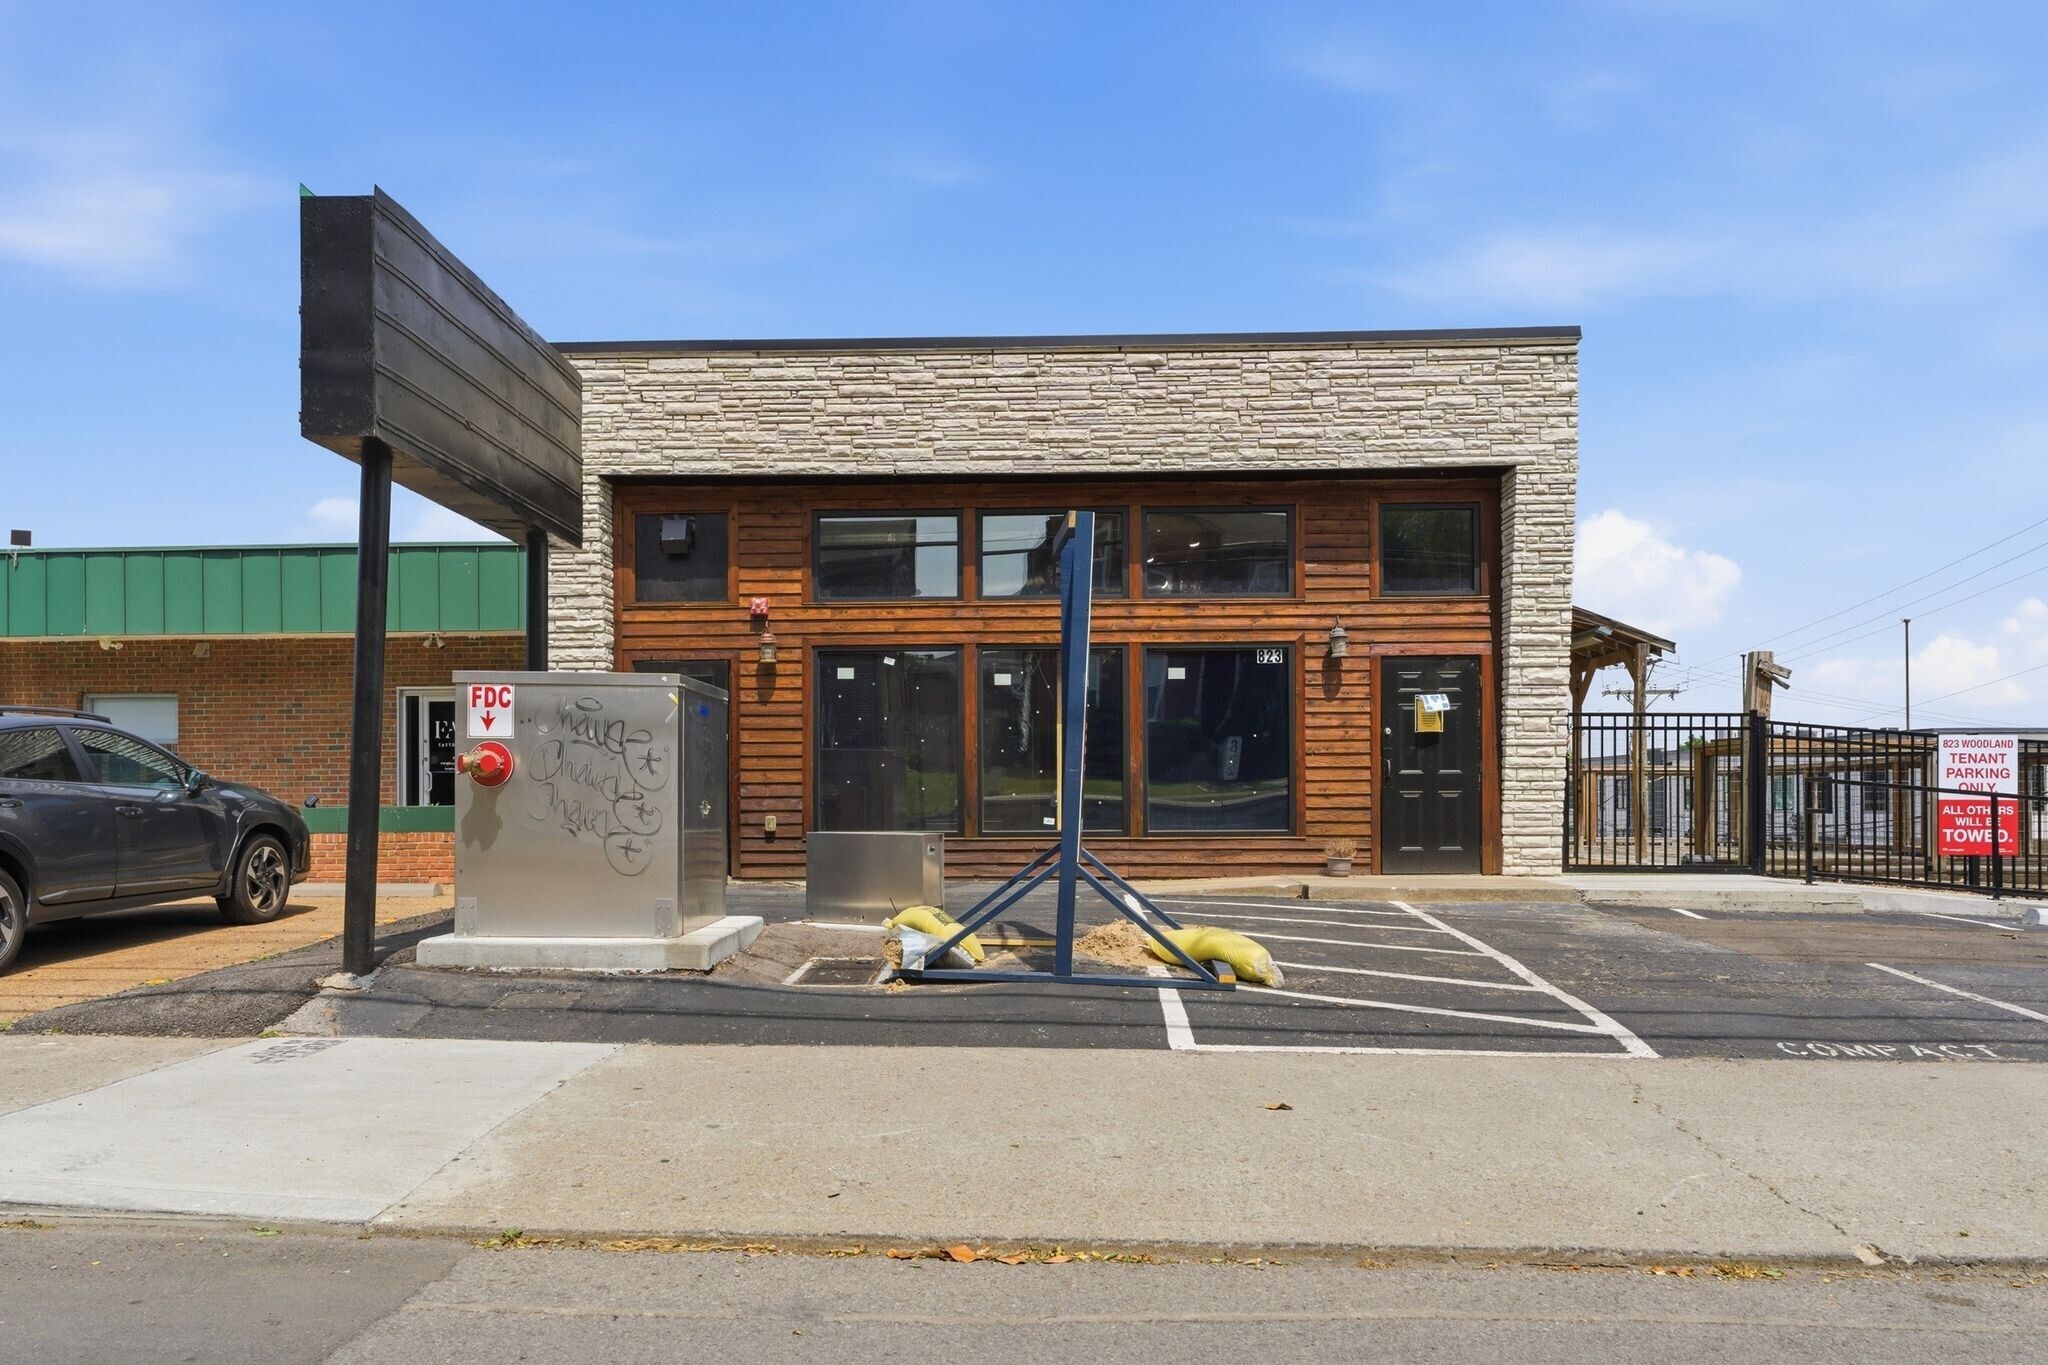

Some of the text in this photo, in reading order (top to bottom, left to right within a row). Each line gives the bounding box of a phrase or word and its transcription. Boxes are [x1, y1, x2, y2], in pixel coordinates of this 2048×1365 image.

[1258, 649, 1281, 662] 823
[472, 687, 511, 708] FDC
[1943, 740, 2014, 748] 823 WOODLAND
[1950, 753, 2007, 764] TENANT
[1946, 768, 2010, 779] PARKING
[1943, 806, 2014, 815] ALL OTHRS
[1955, 817, 1983, 826] WILL
